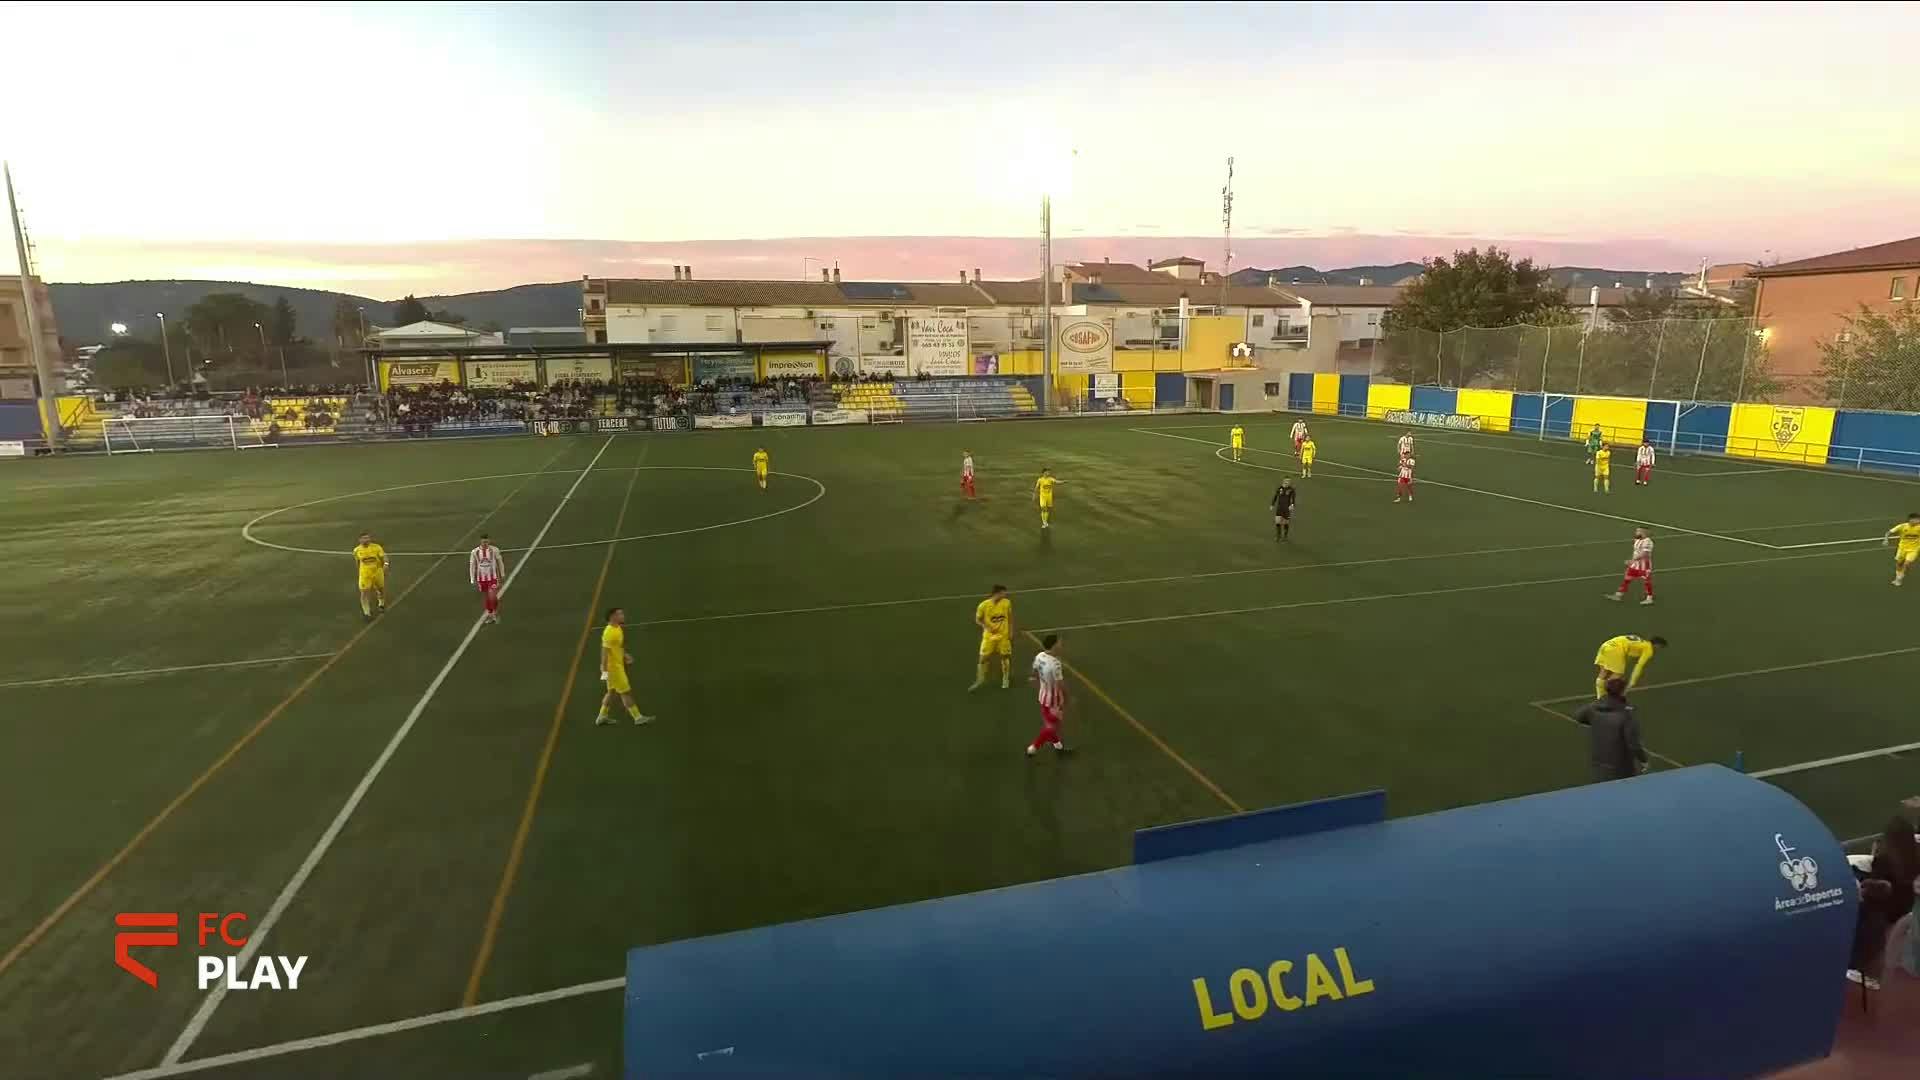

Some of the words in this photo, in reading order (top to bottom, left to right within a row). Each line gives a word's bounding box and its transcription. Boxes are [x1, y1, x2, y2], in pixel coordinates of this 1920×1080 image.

[598, 418, 628, 428] TERCERA
[1773, 422, 1779, 430] C
[1791, 423, 1799, 432] D
[1192, 947, 1375, 1031] LOCAL
